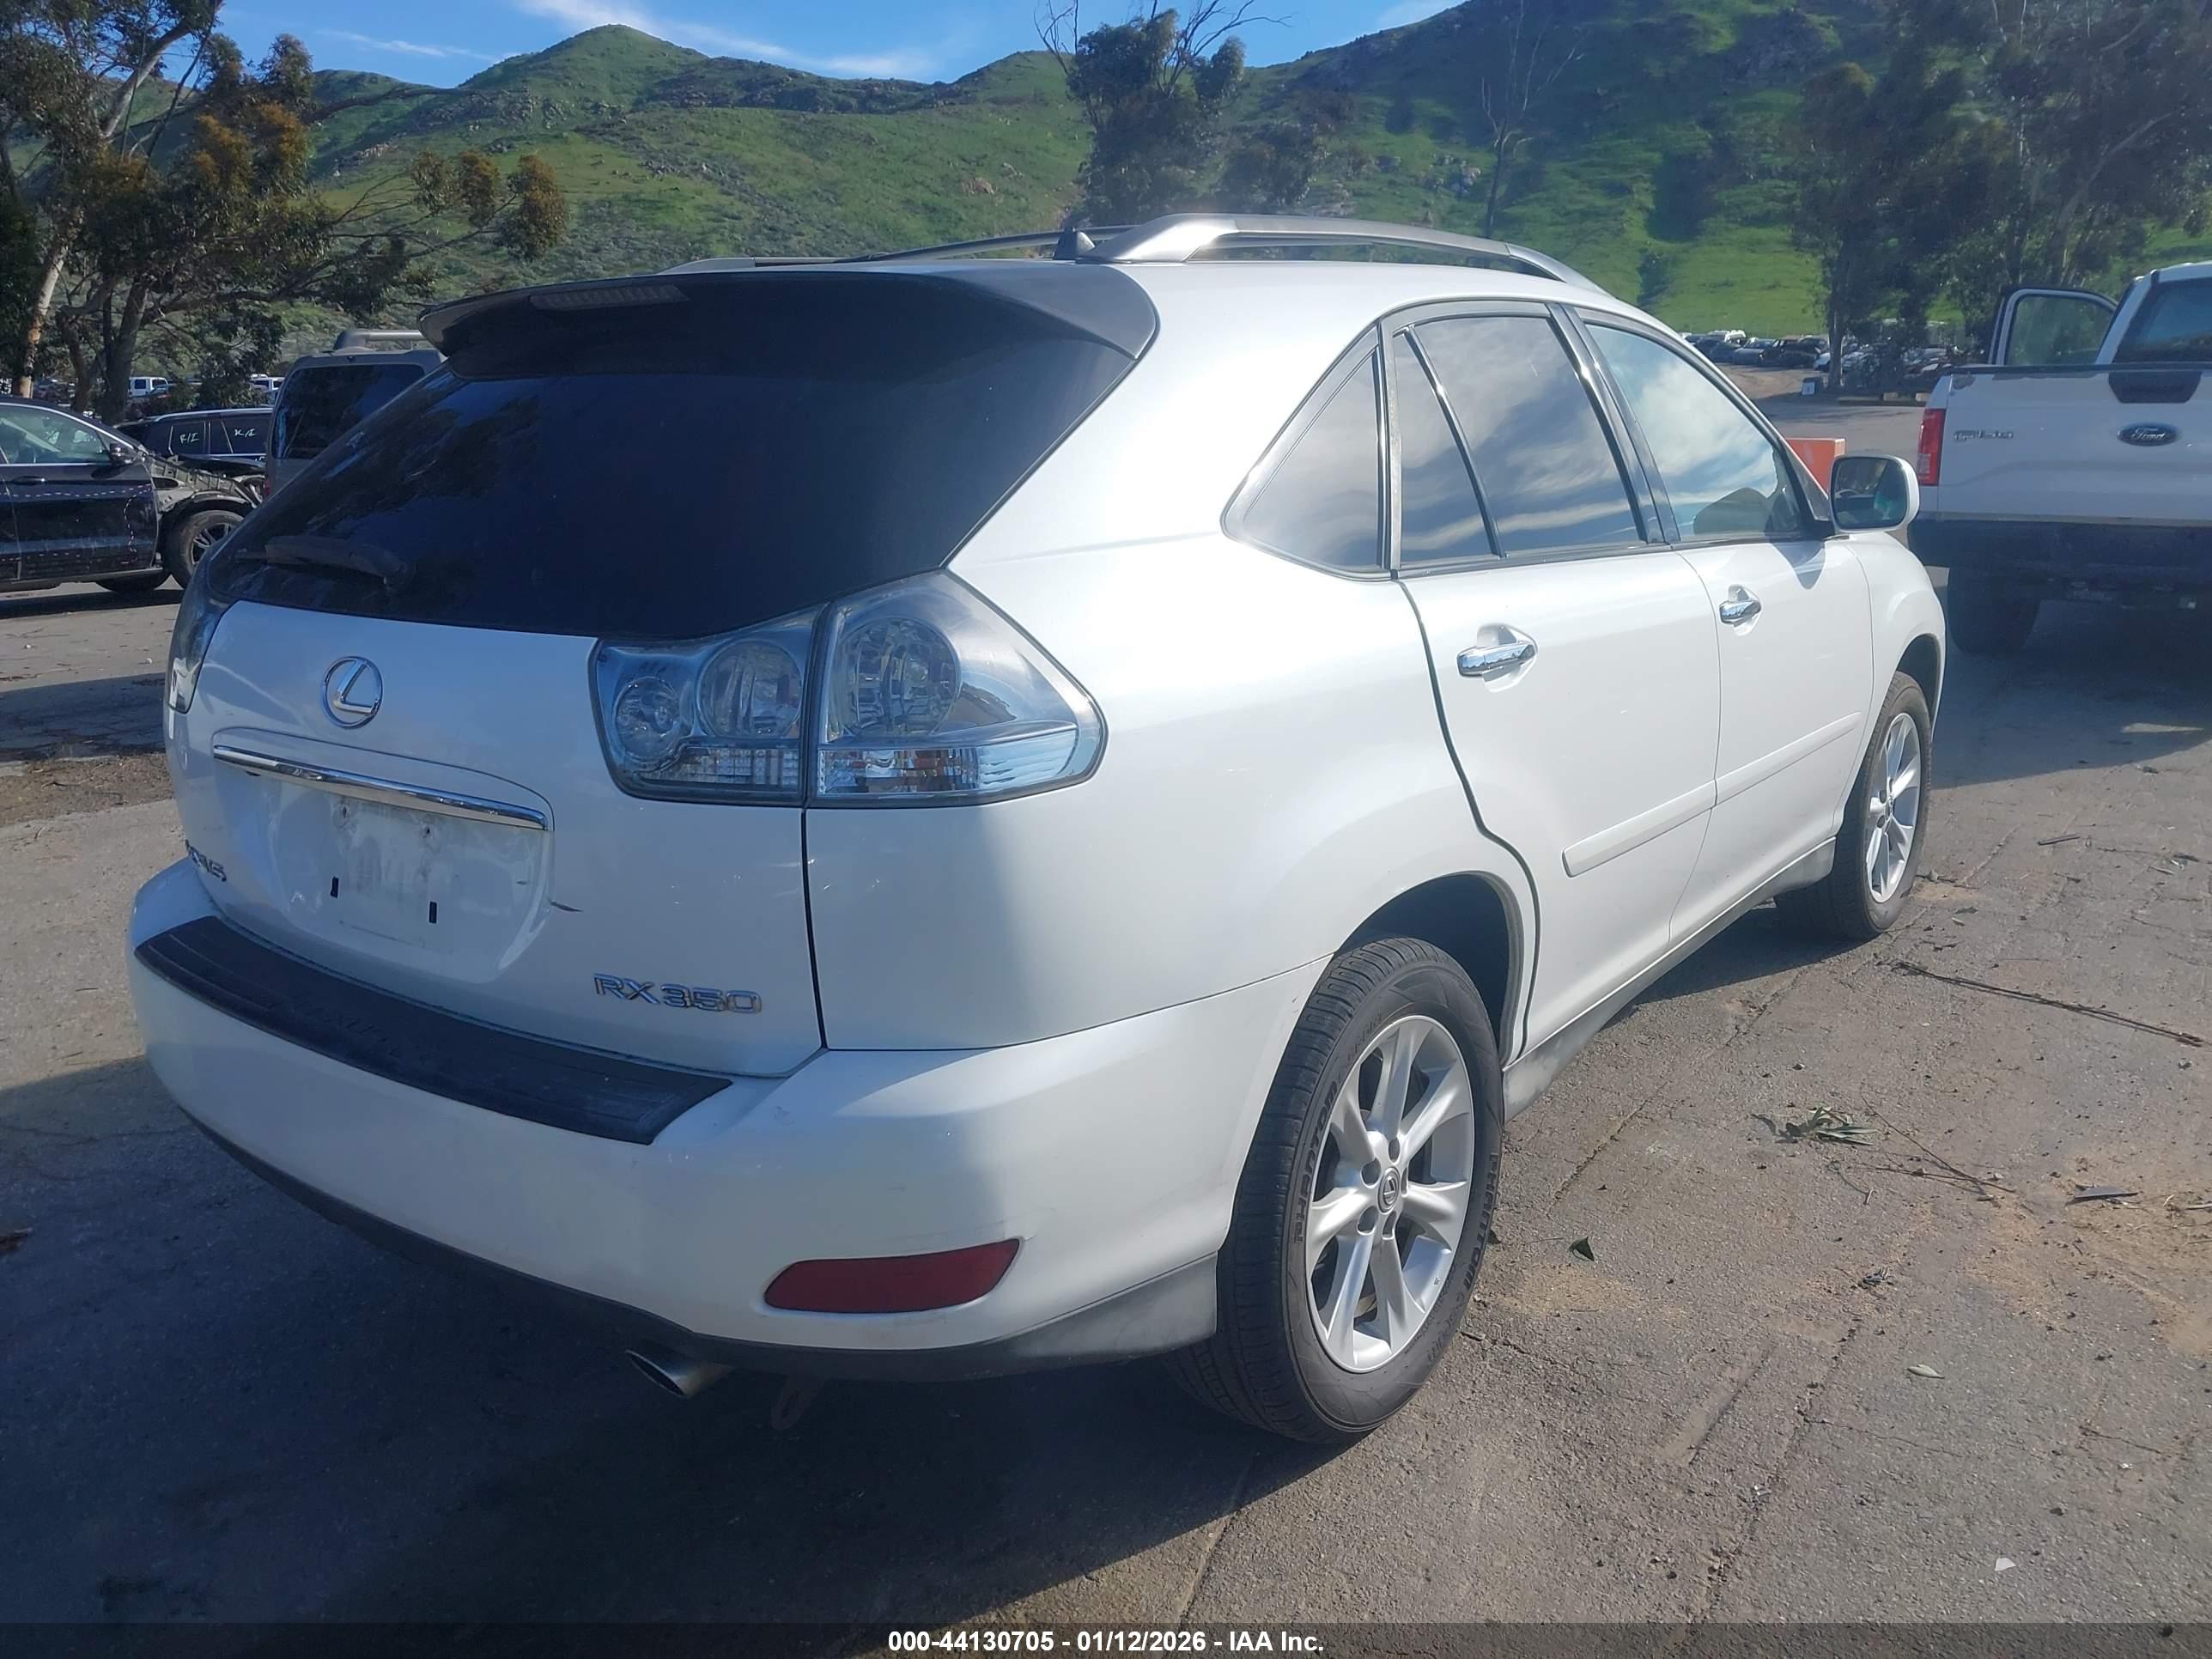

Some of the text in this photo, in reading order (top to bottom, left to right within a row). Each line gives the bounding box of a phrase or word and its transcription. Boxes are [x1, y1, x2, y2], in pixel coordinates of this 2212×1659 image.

[2130, 427, 2166, 441] Ford
[592, 972, 763, 1014] RX 350
